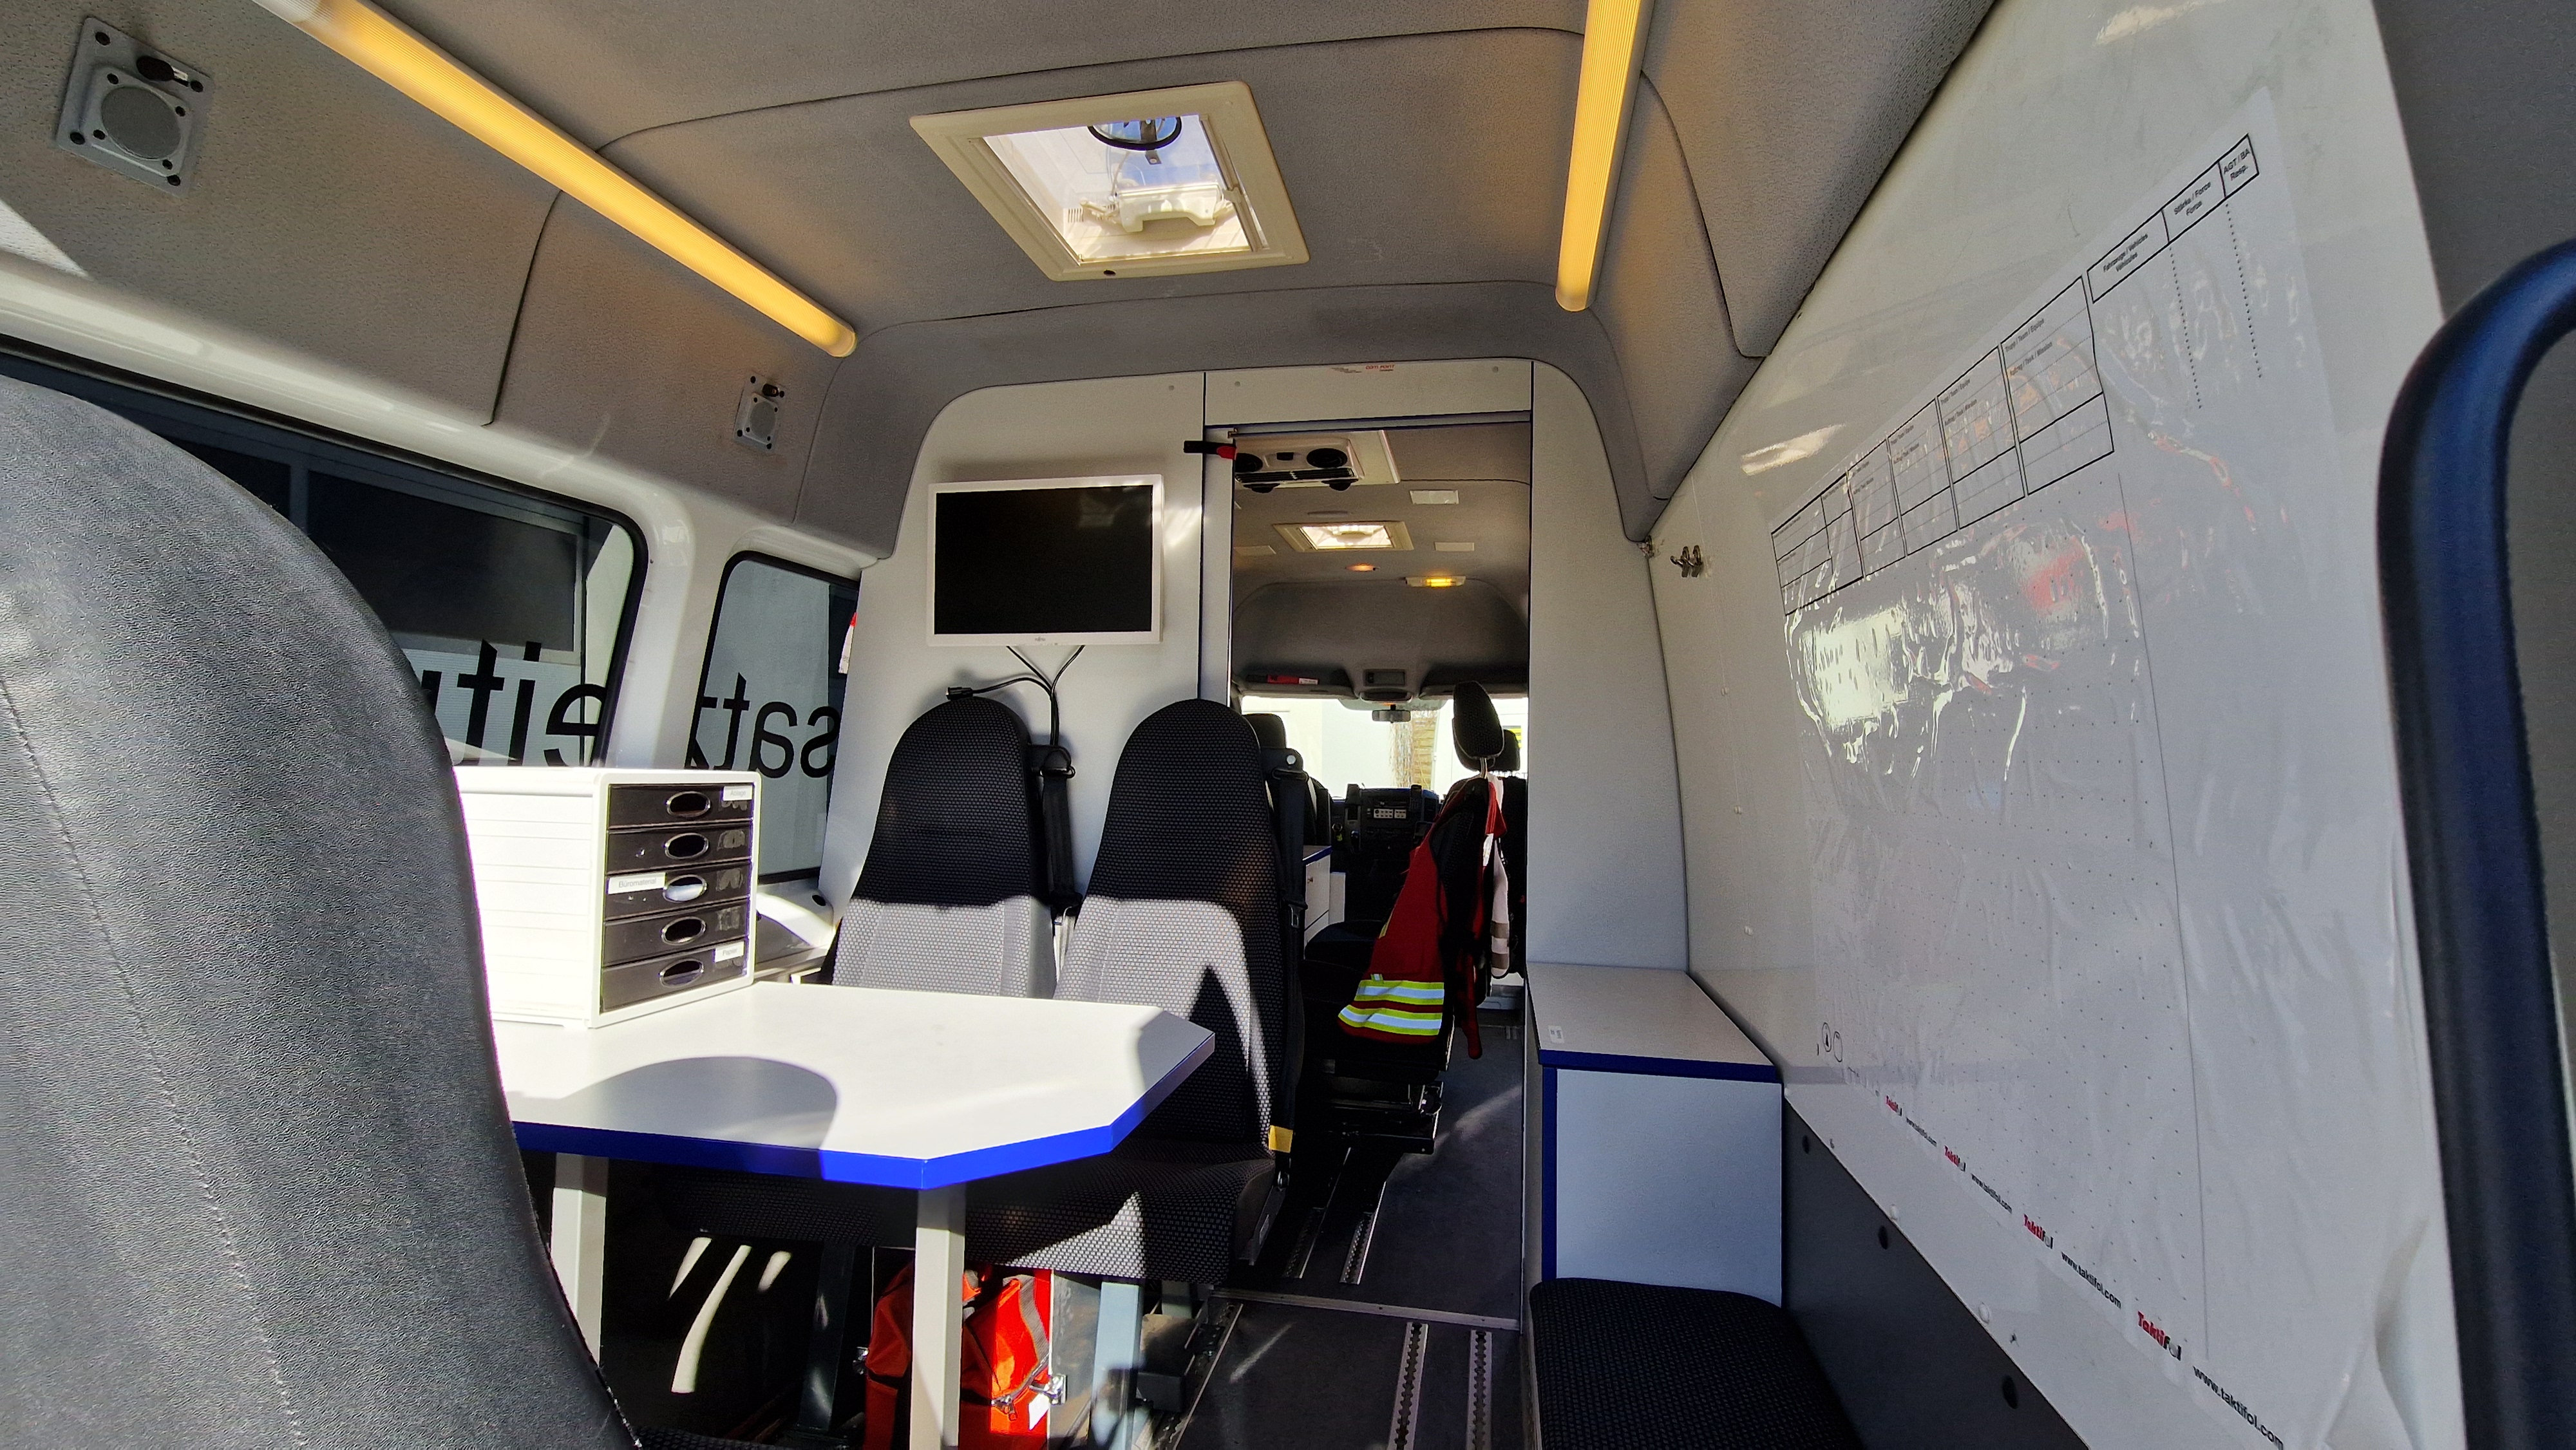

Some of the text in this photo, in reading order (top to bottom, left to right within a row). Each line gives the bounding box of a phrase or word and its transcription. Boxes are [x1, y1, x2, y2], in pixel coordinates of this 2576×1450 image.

[618, 877, 657, 888] Büromaterial
[2061, 1251, 2121, 1310] www.taktifol.com
[2192, 1365, 2284, 1450] www.taktifol.com
